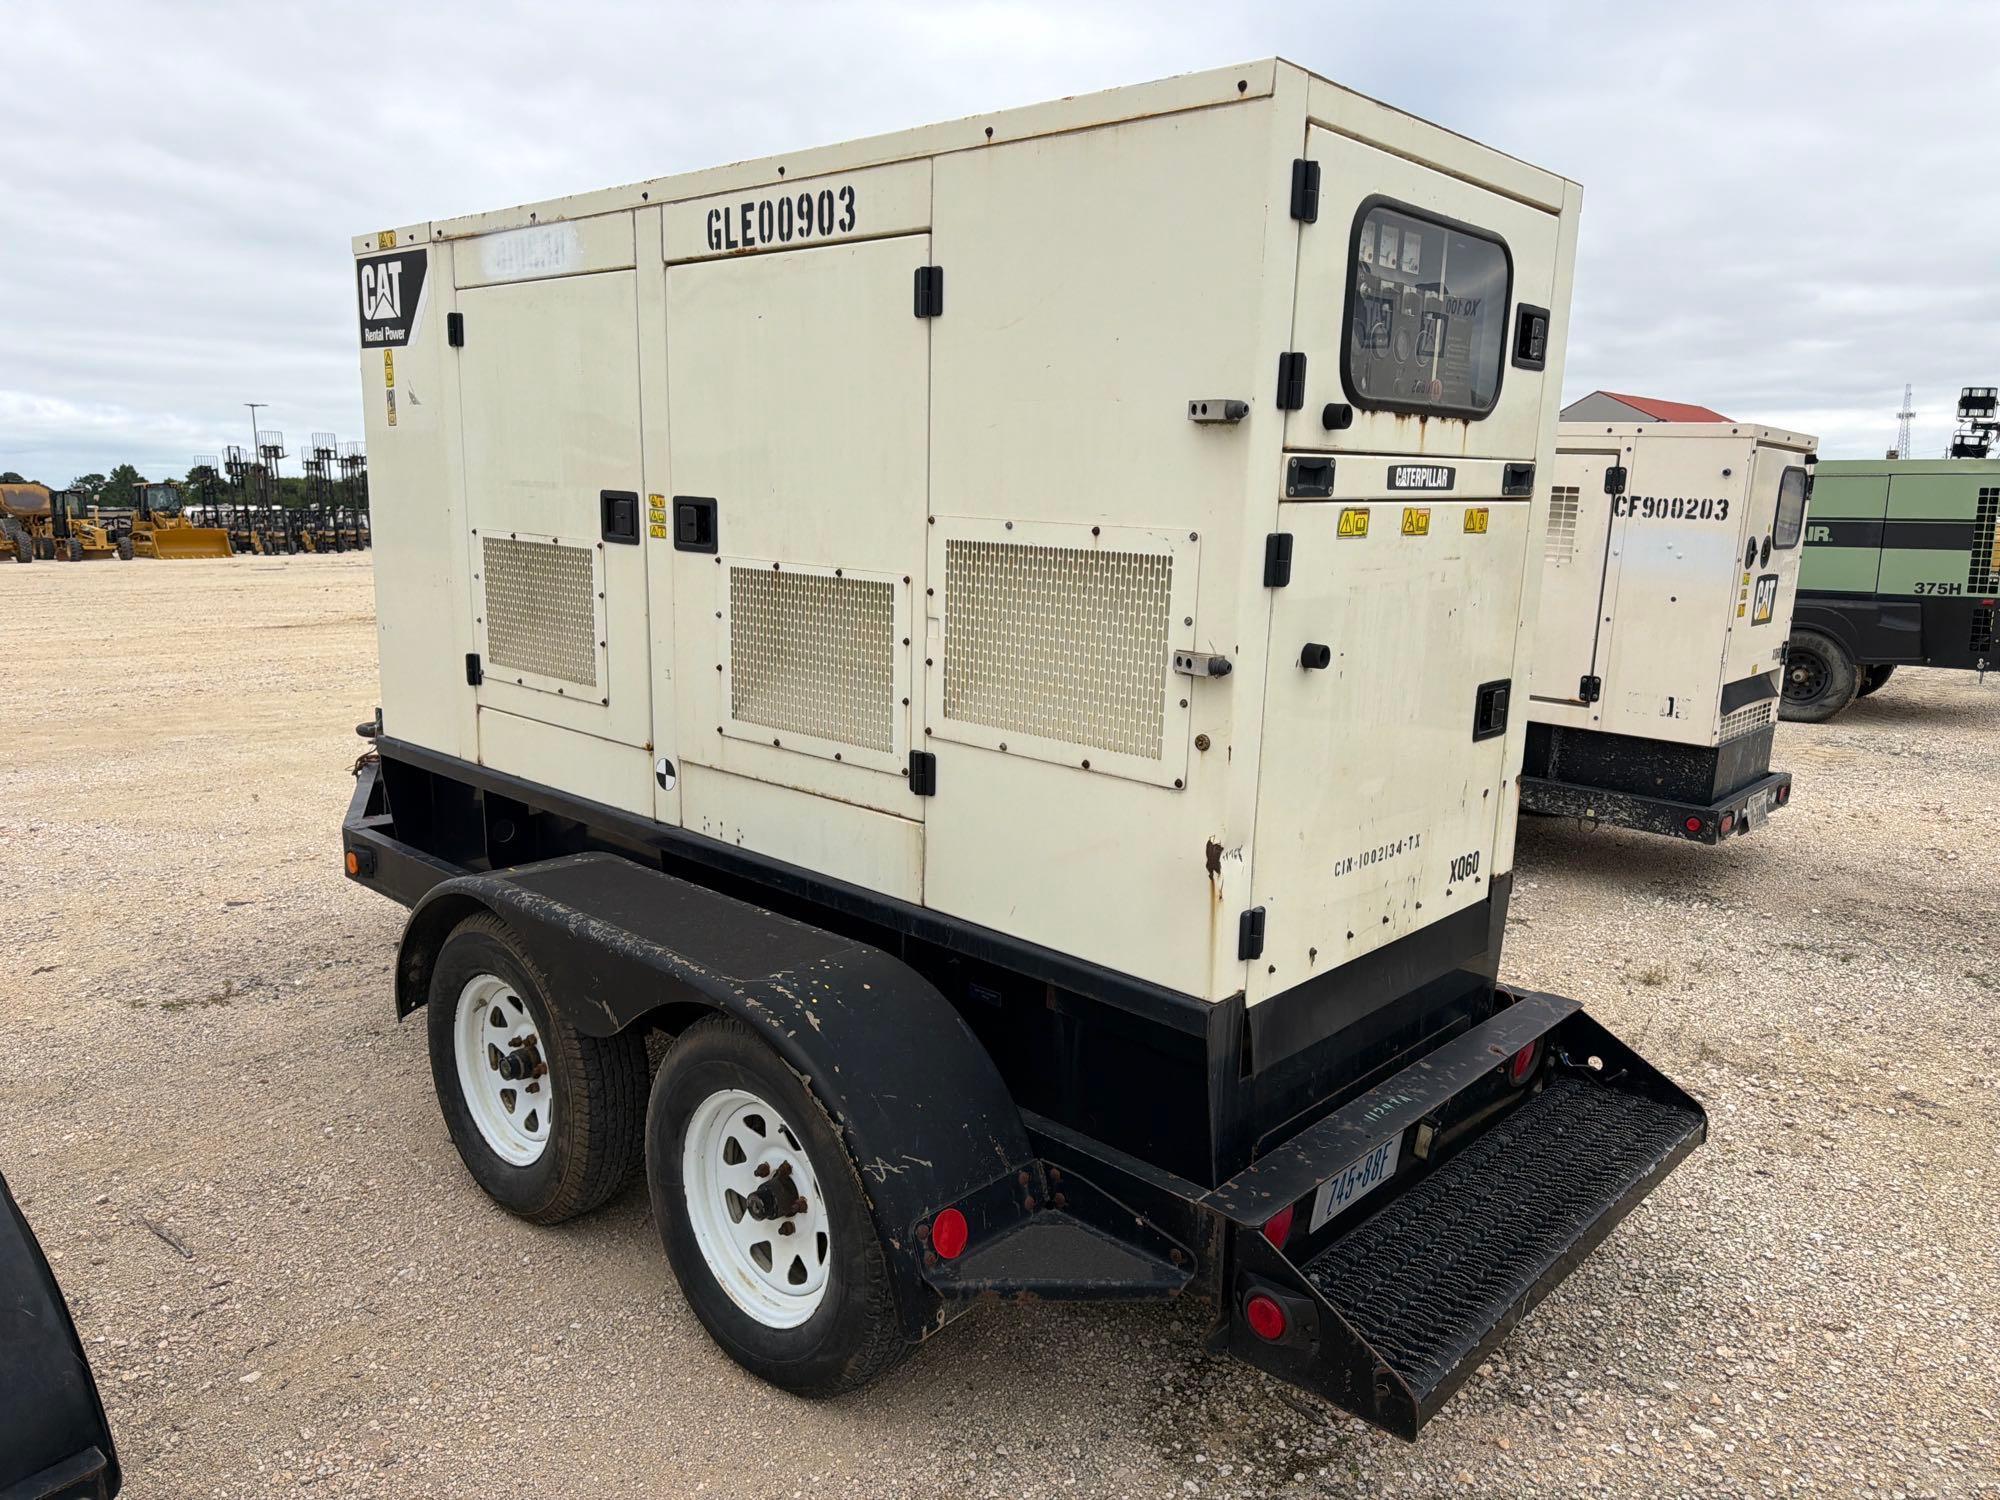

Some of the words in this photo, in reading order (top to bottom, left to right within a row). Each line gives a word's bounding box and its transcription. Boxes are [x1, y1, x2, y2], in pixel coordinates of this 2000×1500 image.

[707, 185, 856, 250] GLE00903
[361, 261, 402, 320] CAT
[364, 326, 384, 341] Rental
[385, 326, 405, 340] Power
[1395, 467, 1448, 488] CATERPILLAR
[1614, 495, 1729, 521] CF900203
[1804, 526, 1830, 541] IR
[1754, 579, 1776, 621] CAT
[1914, 582, 1962, 595] 375H
[1449, 850, 1480, 884] XQ60
